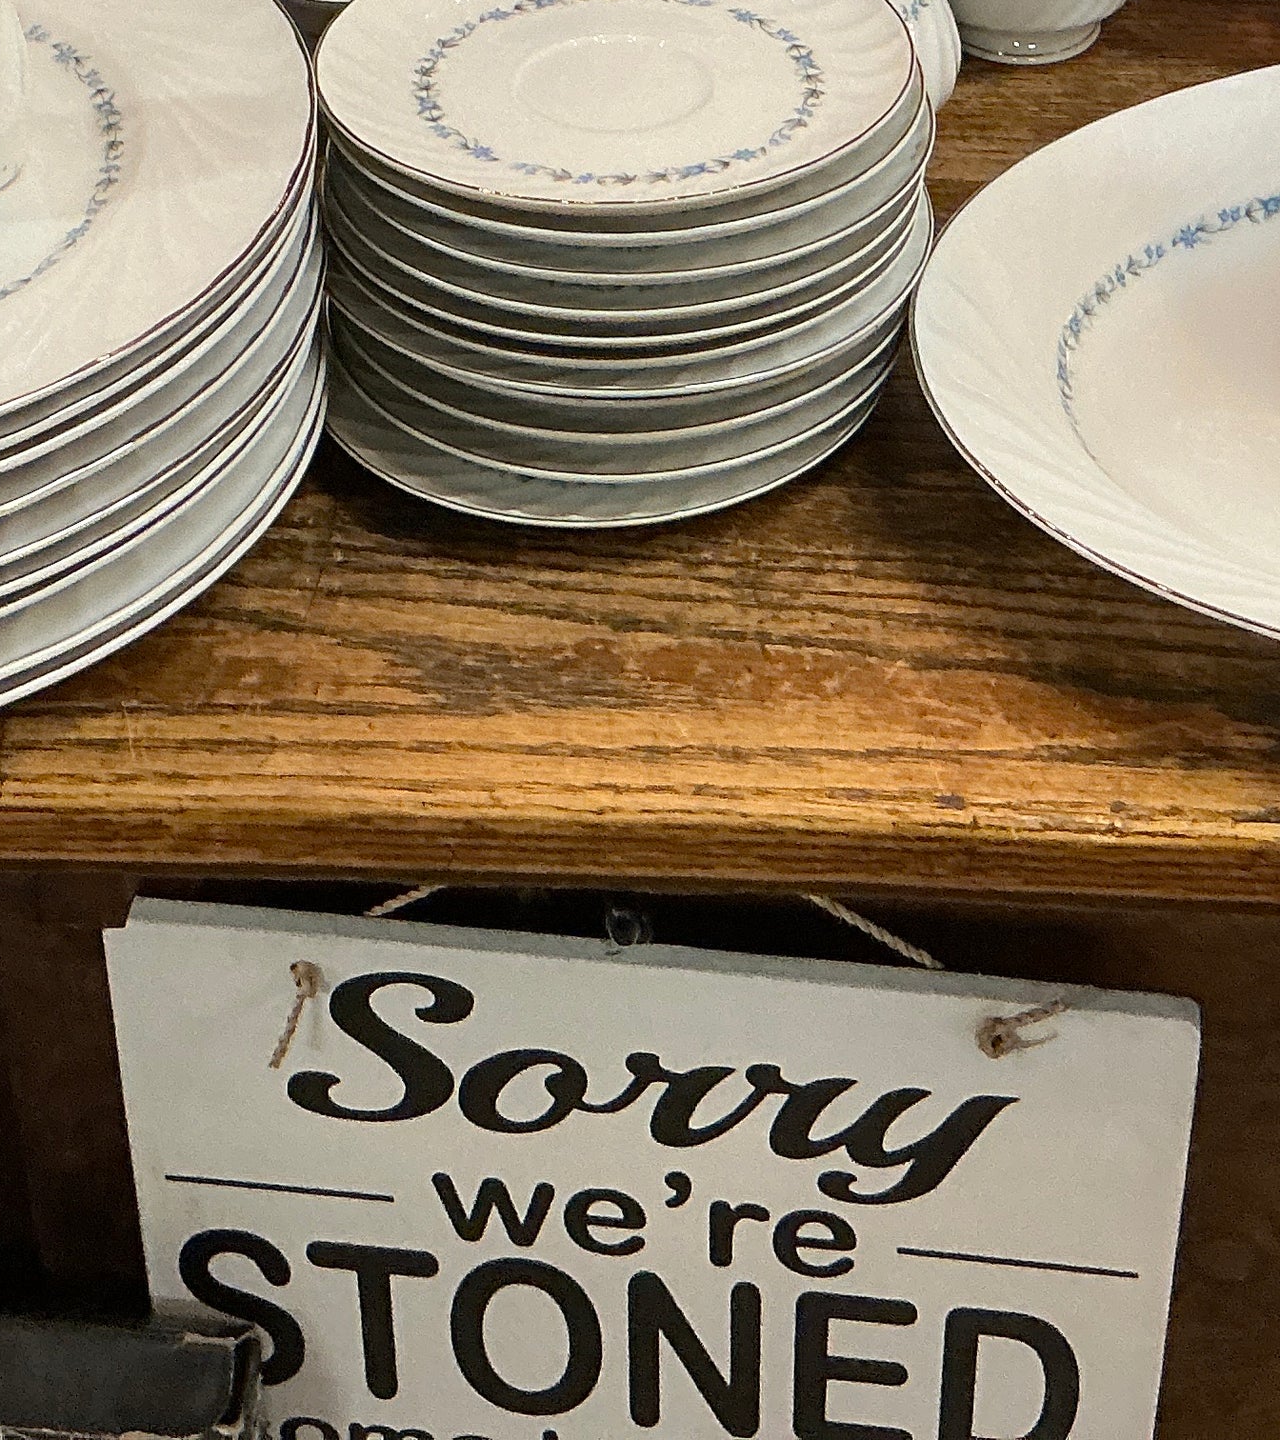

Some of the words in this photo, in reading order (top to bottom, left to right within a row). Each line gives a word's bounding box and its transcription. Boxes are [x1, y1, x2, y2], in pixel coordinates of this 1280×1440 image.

[287, 971, 1020, 1205] Sorry
[431, 1171, 858, 1279] we're
[178, 1227, 1081, 1440] STONED
